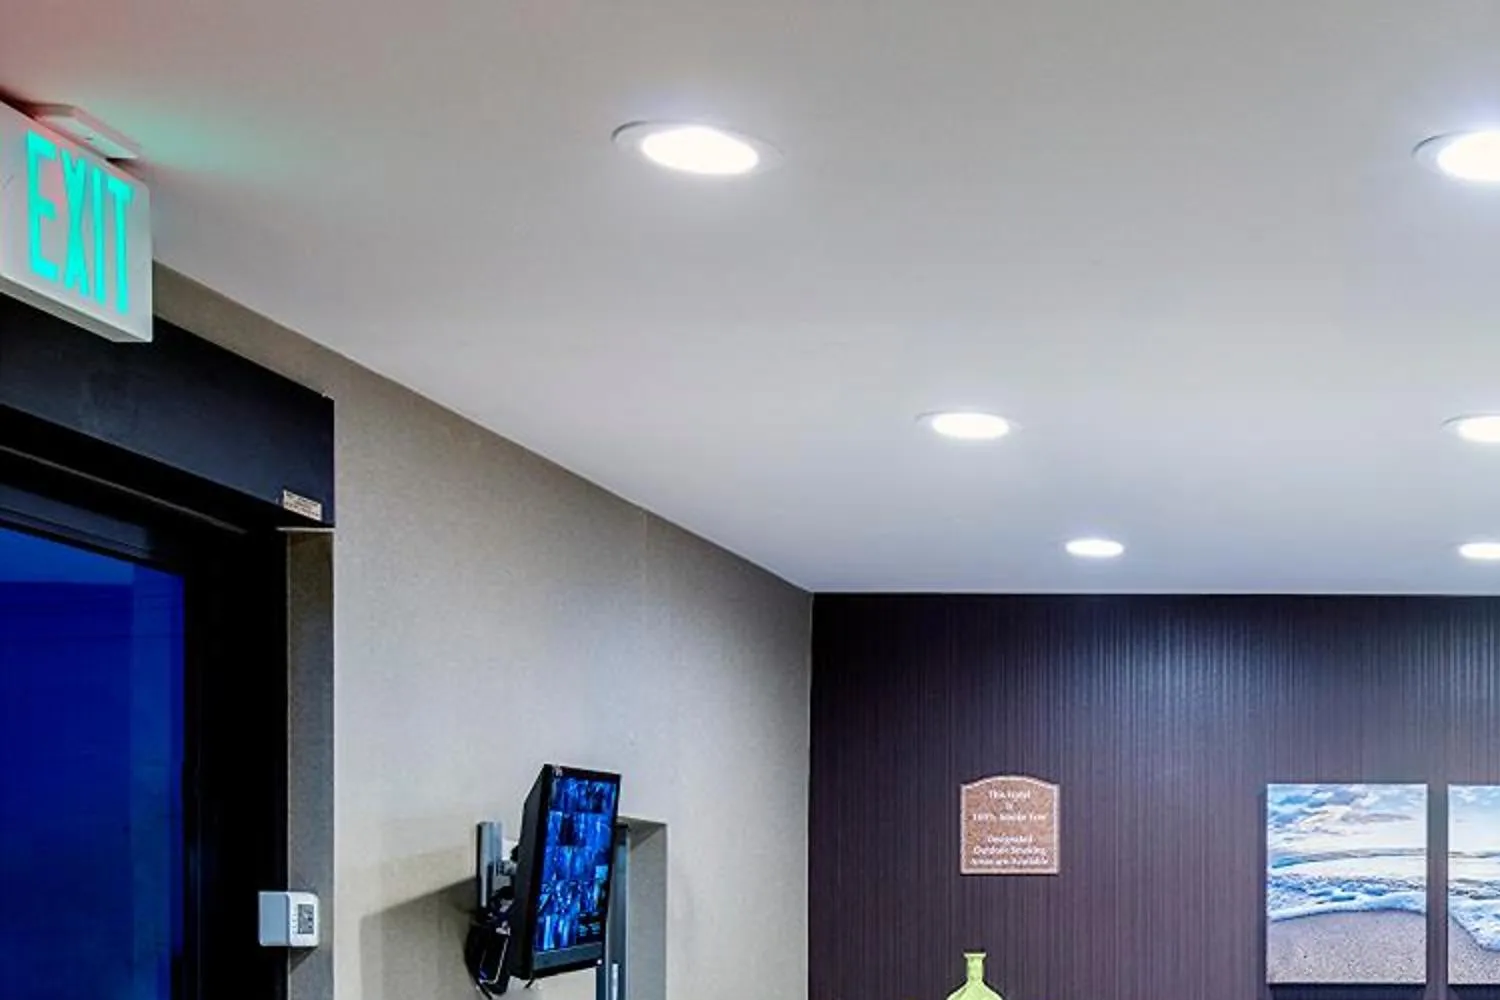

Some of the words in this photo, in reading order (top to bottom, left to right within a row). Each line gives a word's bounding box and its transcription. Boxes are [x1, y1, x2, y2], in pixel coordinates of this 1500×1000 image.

[26, 128, 134, 316] EXIT
[1007, 789, 1031, 799] Hotel
[999, 811, 1027, 821] Smoke
